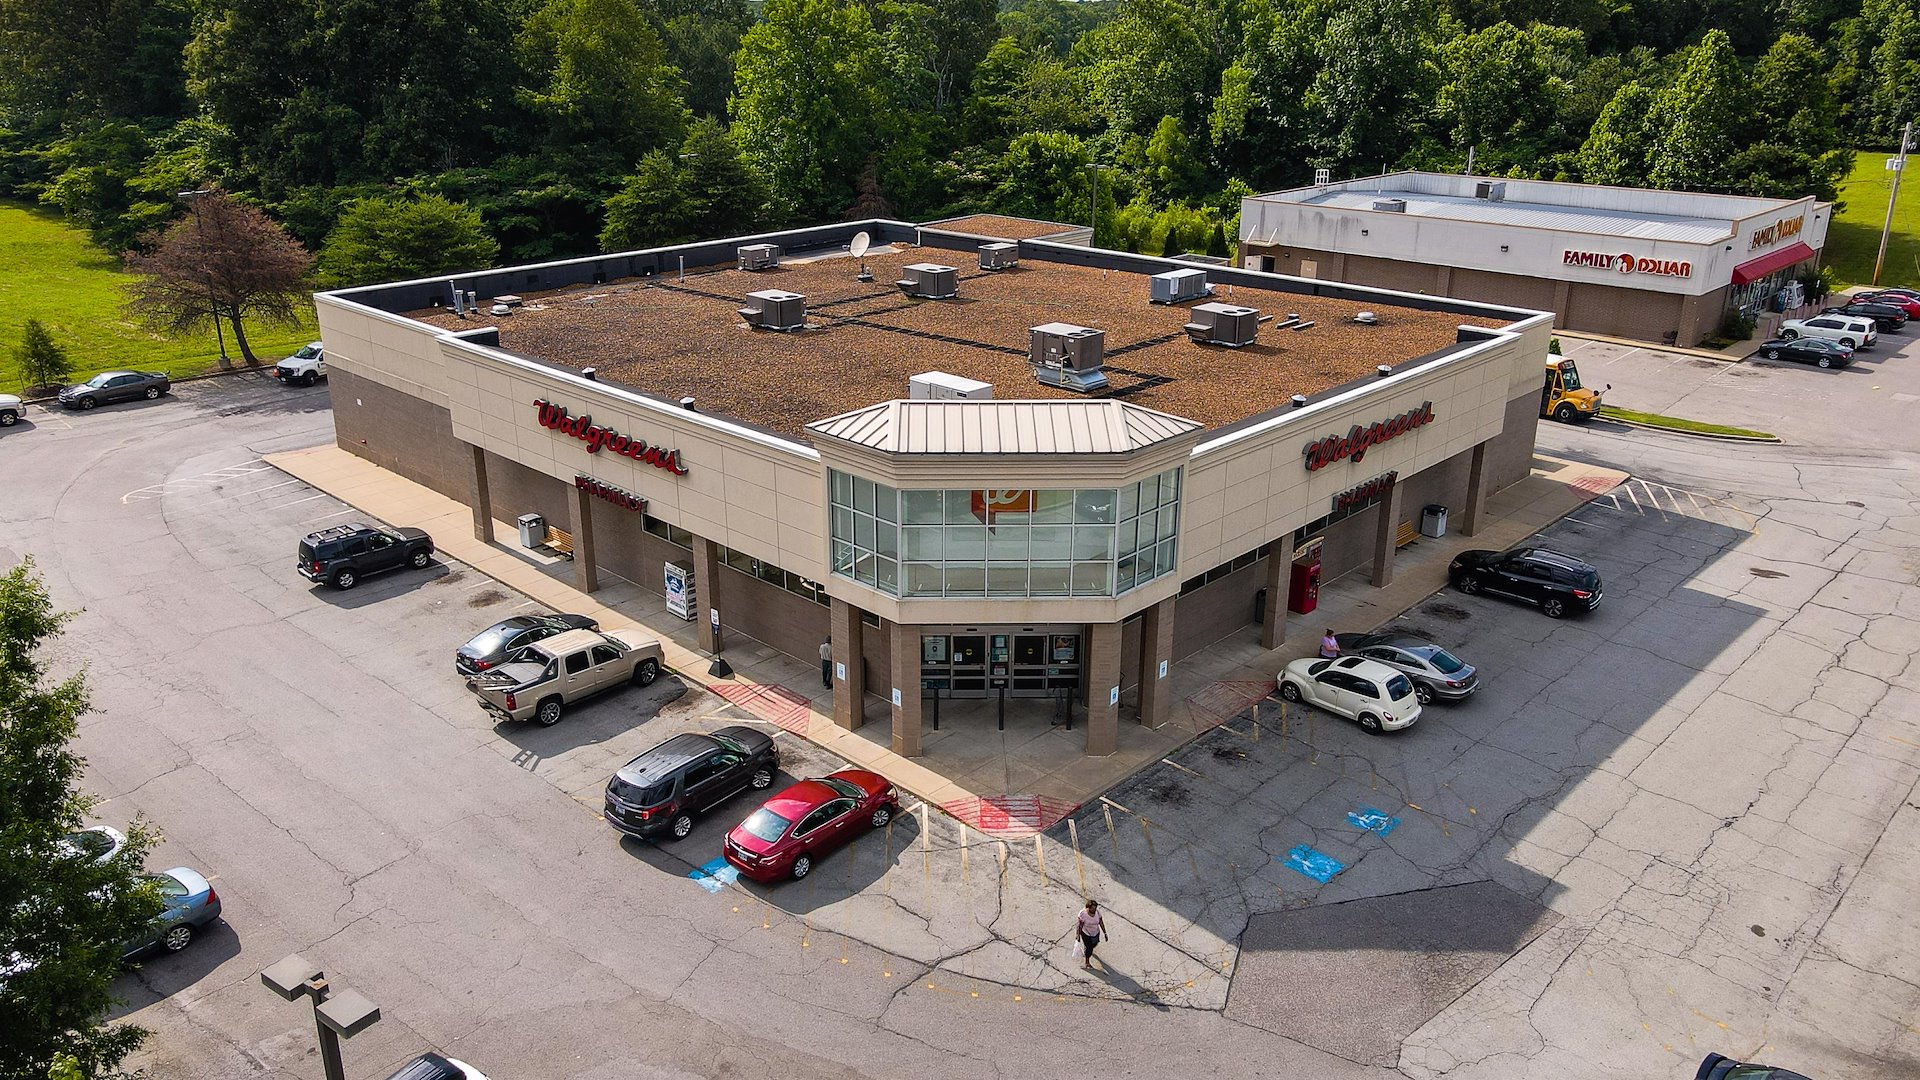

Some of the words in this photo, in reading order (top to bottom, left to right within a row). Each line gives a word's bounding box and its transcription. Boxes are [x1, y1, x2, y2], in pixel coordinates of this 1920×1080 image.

[1751, 224, 1775, 249] FAMILY
[1563, 249, 1615, 269] FAMILY
[1637, 257, 1692, 278] DOLLAR
[533, 398, 689, 476] Walgreens
[1303, 401, 1435, 472] Walgreens
